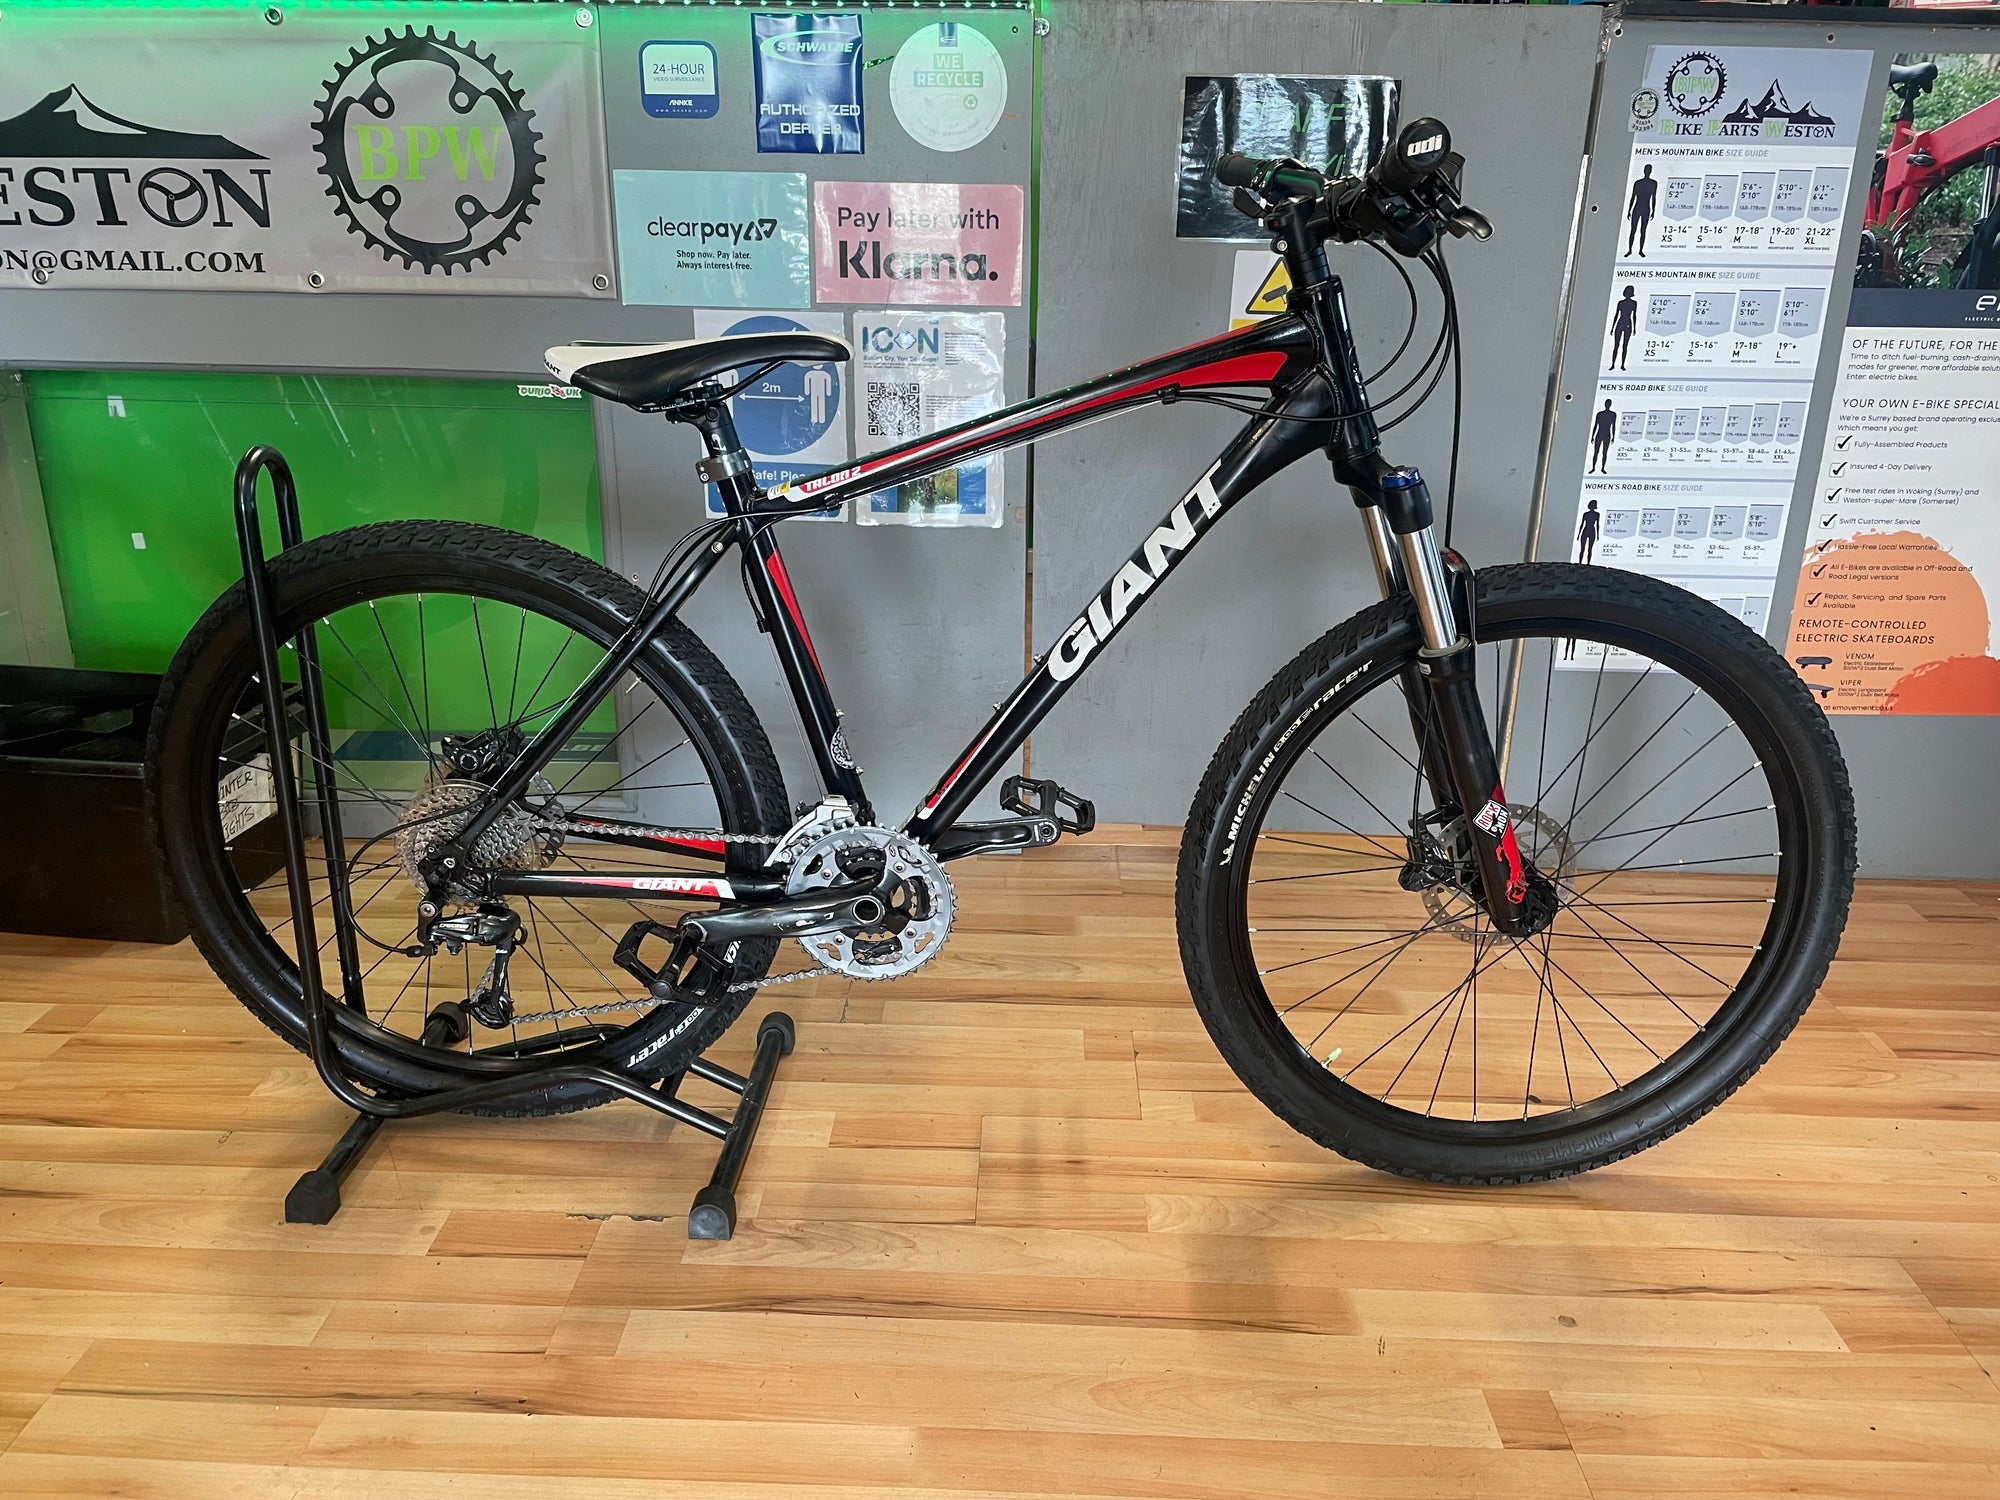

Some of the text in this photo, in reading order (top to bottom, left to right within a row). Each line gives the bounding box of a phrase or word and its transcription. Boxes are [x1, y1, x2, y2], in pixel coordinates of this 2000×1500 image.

[777, 42, 854, 52] SCHWALBE
[936, 54, 961, 68] WE
[653, 63, 705, 75] 24-HOUR
[917, 73, 980, 86] RECYCLE
[1674, 76, 1716, 93] BPW
[760, 103, 860, 116] AUTHORIZED
[780, 122, 842, 134] DEALER
[1660, 119, 1702, 136] BIKE
[1706, 120, 1759, 137] PARTS
[1764, 118, 1835, 138] WESTON
[351, 124, 504, 181] BPW
[1661, 148, 1704, 156] MOUNTAIN
[838, 207, 1000, 232] Pay later with
[647, 216, 744, 246] clearpay
[676, 250, 696, 259] Shop
[717, 251, 730, 260] Pay
[838, 240, 998, 281] Klarna.
[0, 249, 268, 274] N@GMAIL.COM
[677, 261, 752, 270] Always interest-free.
[1852, 339, 1998, 351] OF THE FUTURE, FOR THE
[1903, 354, 1950, 362] fuel-burning,
[520, 387, 580, 396] CURIO UK
[762, 382, 781, 393] 2m
[1842, 398, 1950, 409] YOUR OWN E-BIKE
[1941, 415, 1977, 424] operating
[805, 466, 862, 492] TALON 2
[1934, 488, 1963, 496] (Surrey)
[1919, 497, 1959, 506] (Somerset)
[1048, 458, 1222, 682] GIANT
[1799, 619, 1926, 630] REMOTE-CONTROLLED
[1796, 634, 1935, 644] ELECTRIC SKATEBOARDS
[219, 771, 253, 800] INTER
[1228, 752, 1275, 840] MICHELIN
[632, 878, 704, 891] GIANT
